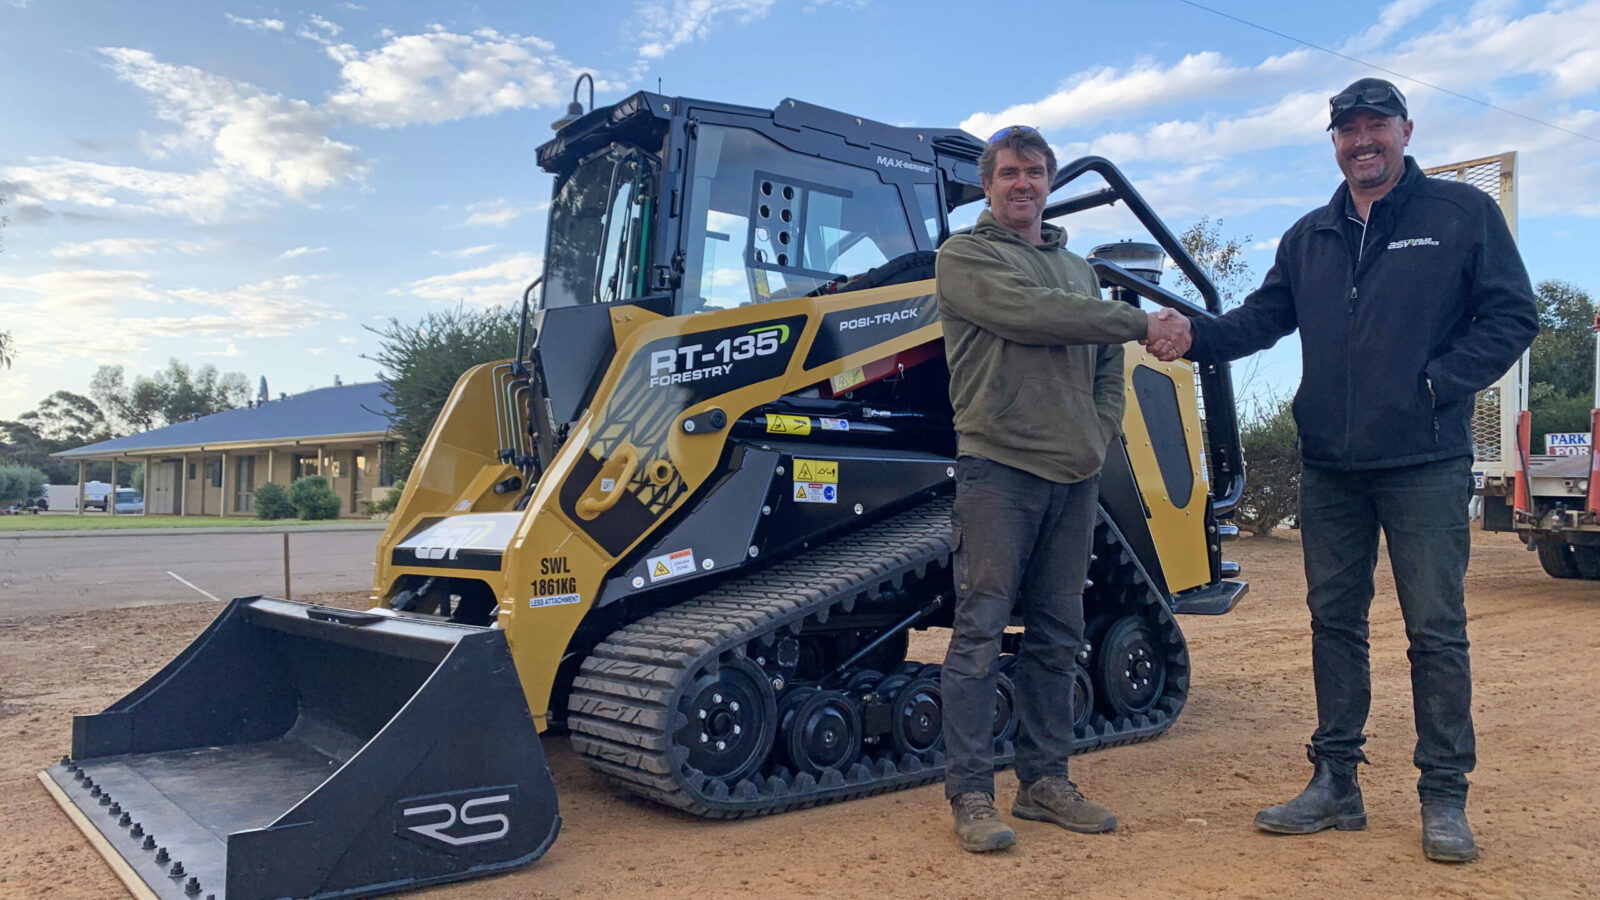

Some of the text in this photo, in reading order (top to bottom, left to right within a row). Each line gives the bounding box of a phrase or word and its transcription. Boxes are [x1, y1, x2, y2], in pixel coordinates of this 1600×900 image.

[839, 308, 918, 332] POSI-TRACK
[650, 330, 779, 377] RT-135
[649, 363, 734, 389] FORESTRY
[1551, 434, 1587, 445] PARK
[1554, 446, 1589, 456] FOR
[540, 556, 571, 575] SWL
[530, 576, 577, 597] 1861KG
[530, 595, 579, 607] LESS ATTACHMENT
[403, 794, 510, 846] RS
